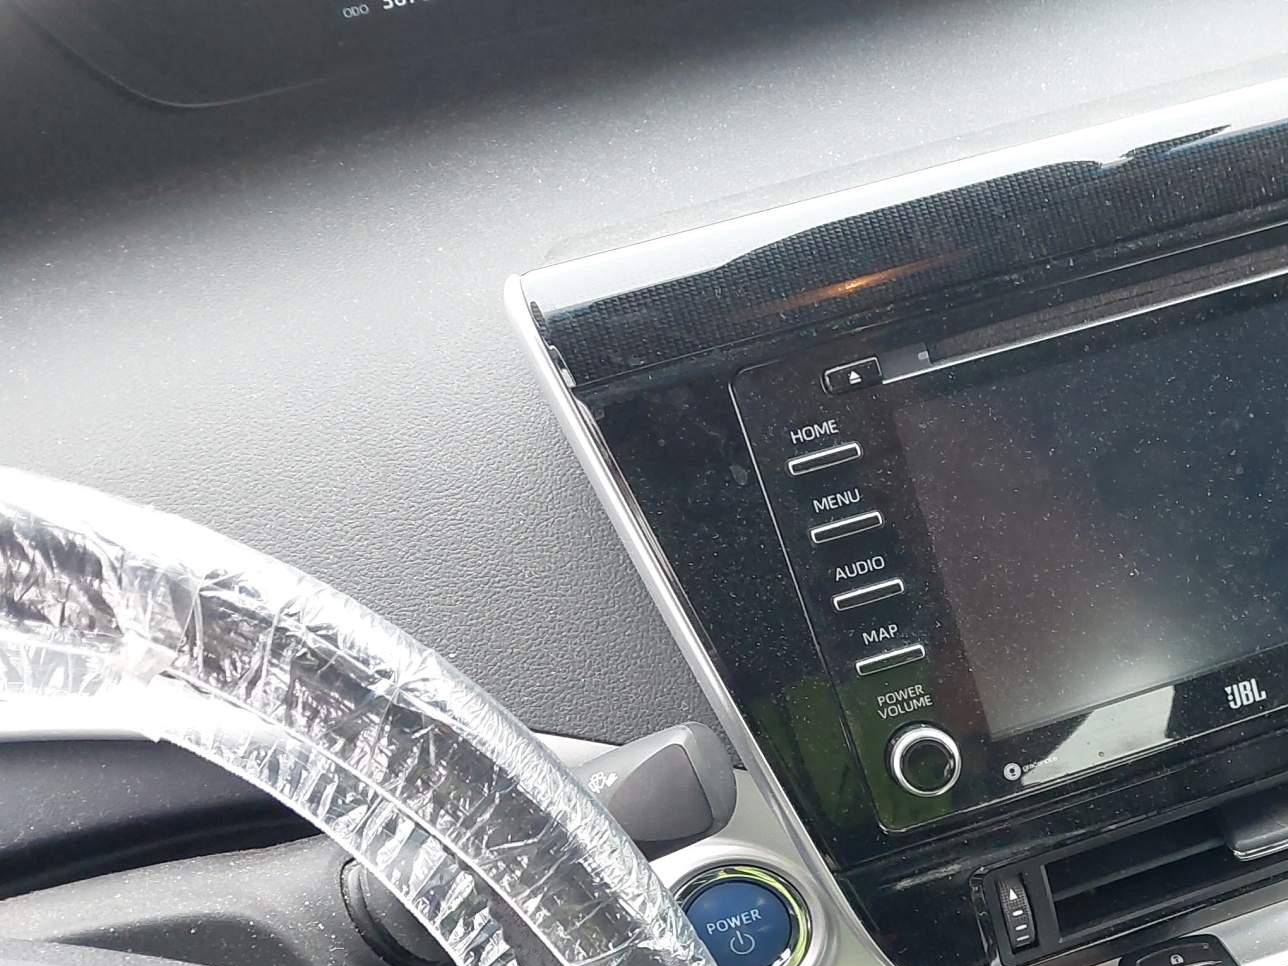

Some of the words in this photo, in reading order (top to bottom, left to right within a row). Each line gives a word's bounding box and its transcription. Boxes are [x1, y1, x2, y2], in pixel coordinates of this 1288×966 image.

[342, 4, 369, 18] ODO
[790, 419, 839, 444] HOME
[812, 488, 861, 513] MENU
[835, 555, 886, 581] AUDIO
[862, 624, 899, 645] MAP
[877, 684, 925, 707] POWER
[1224, 678, 1267, 709] JBL
[877, 695, 933, 719] VOLUME
[706, 909, 762, 935] POWER
